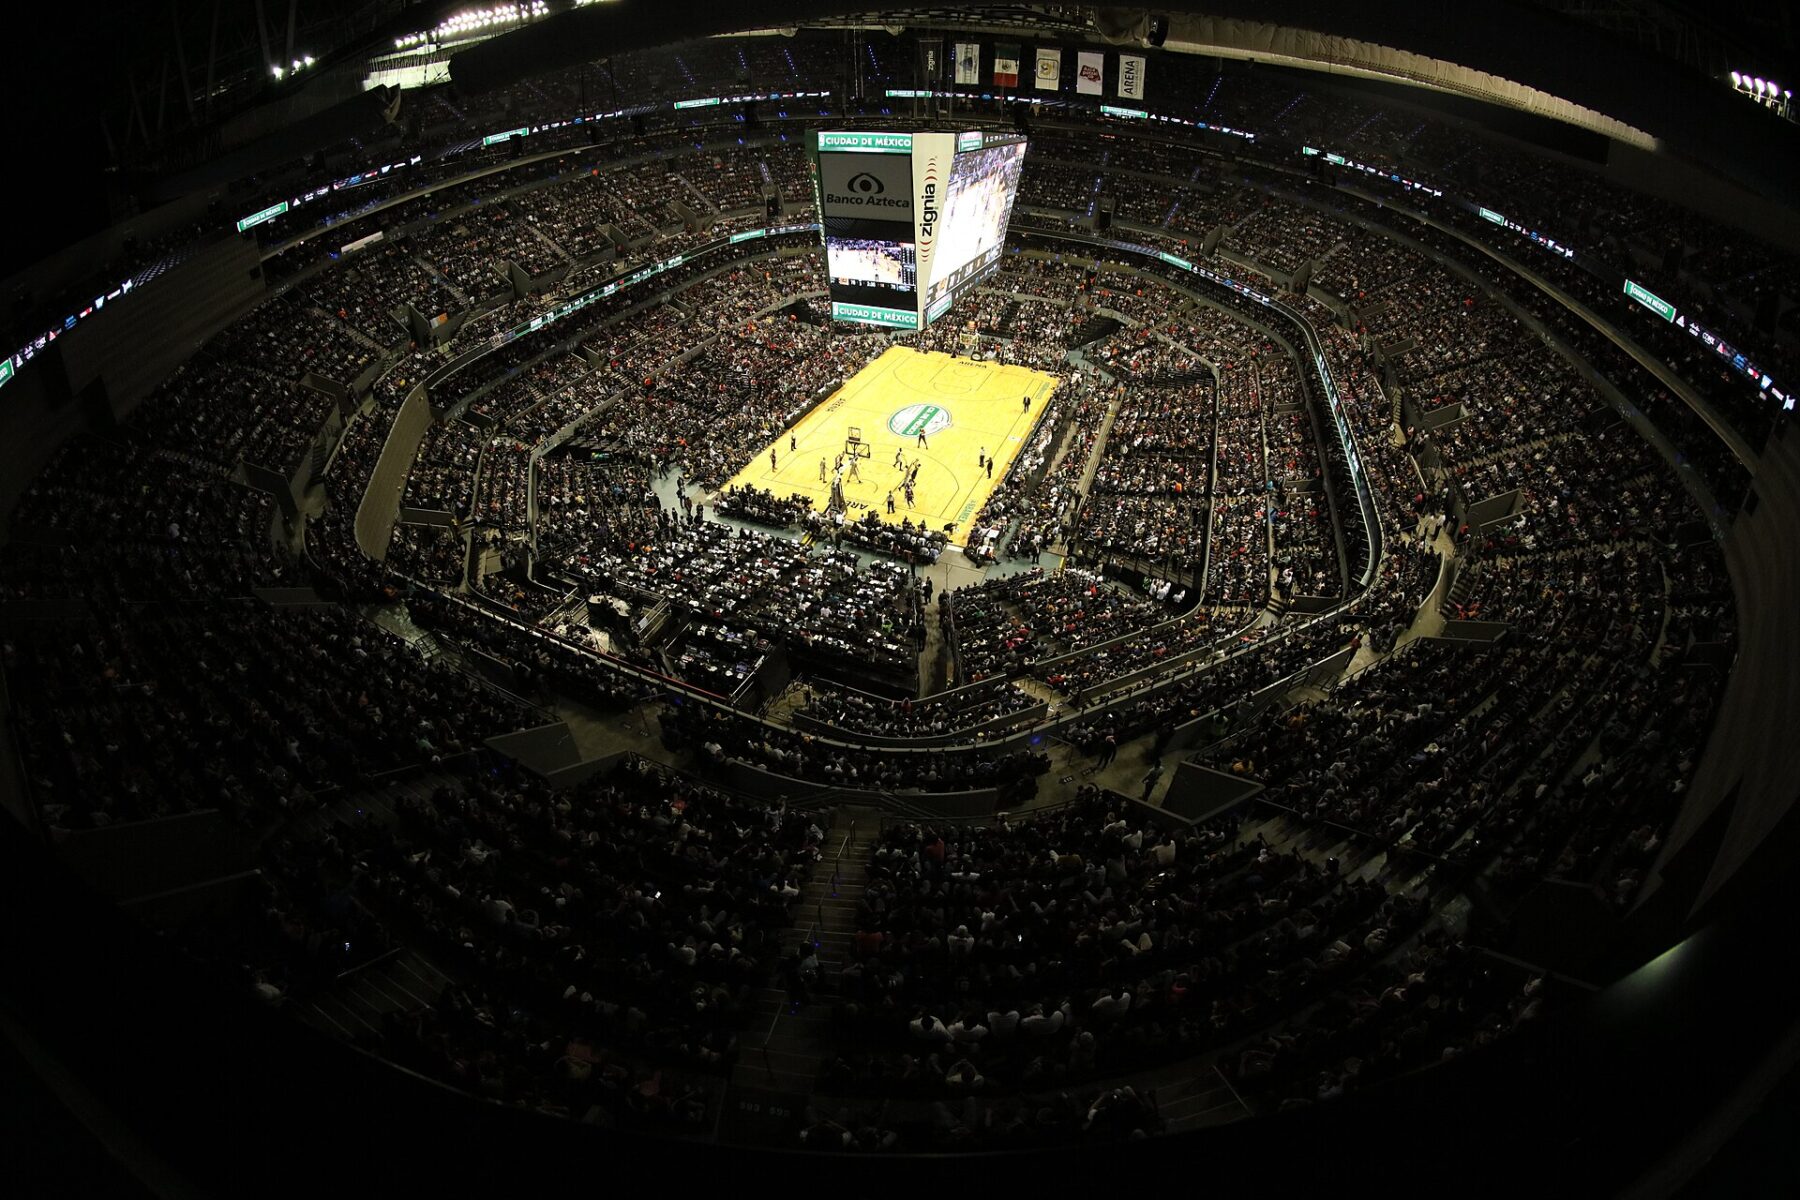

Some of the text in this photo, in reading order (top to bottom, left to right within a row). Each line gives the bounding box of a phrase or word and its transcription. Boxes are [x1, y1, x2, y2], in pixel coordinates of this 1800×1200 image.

[1123, 60, 1136, 95] ARENA
[825, 135, 912, 148] CIUDAD DE MÉXICO
[826, 193, 910, 209] Banco Azteca
[920, 183, 938, 237] zignia
[1632, 287, 1647, 301] CIUDAD
[1652, 298, 1668, 314] MÉXICO
[839, 308, 917, 324] CIUDAD DE MÉXICO
[959, 360, 987, 369] ARENA
